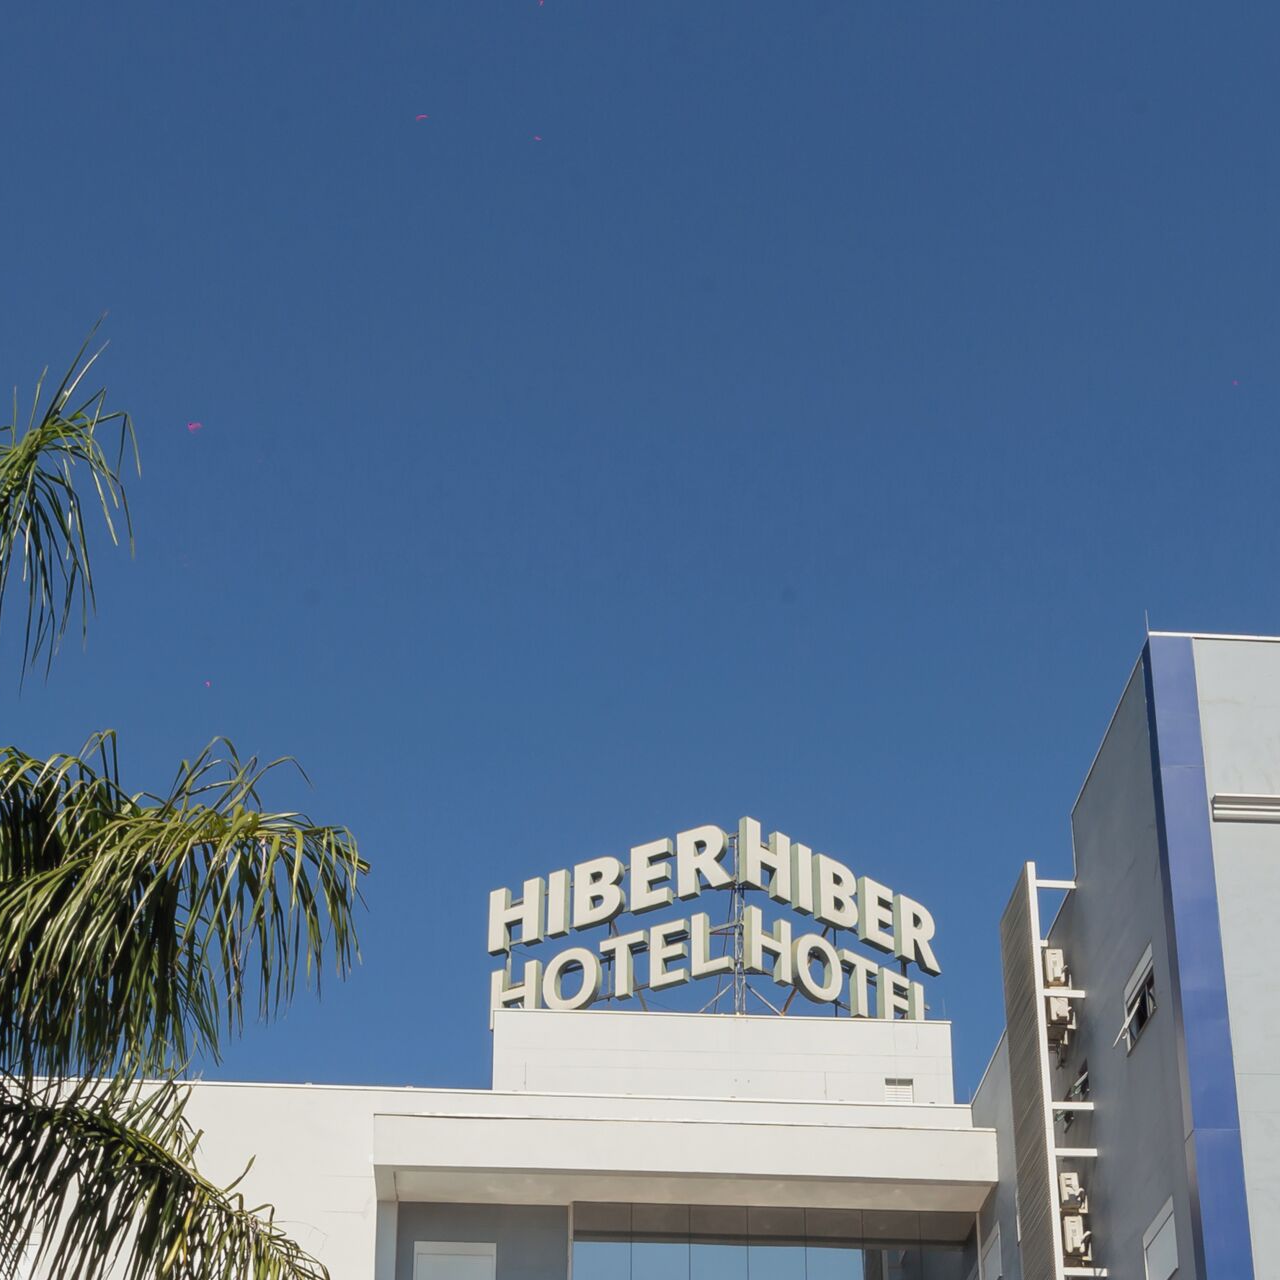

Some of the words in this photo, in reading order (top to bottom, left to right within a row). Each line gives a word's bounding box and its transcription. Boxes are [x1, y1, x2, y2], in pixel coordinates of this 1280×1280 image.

[488, 824, 737, 955] HIBER
[739, 816, 941, 977] HIBER
[490, 912, 735, 1029] HOTEL
